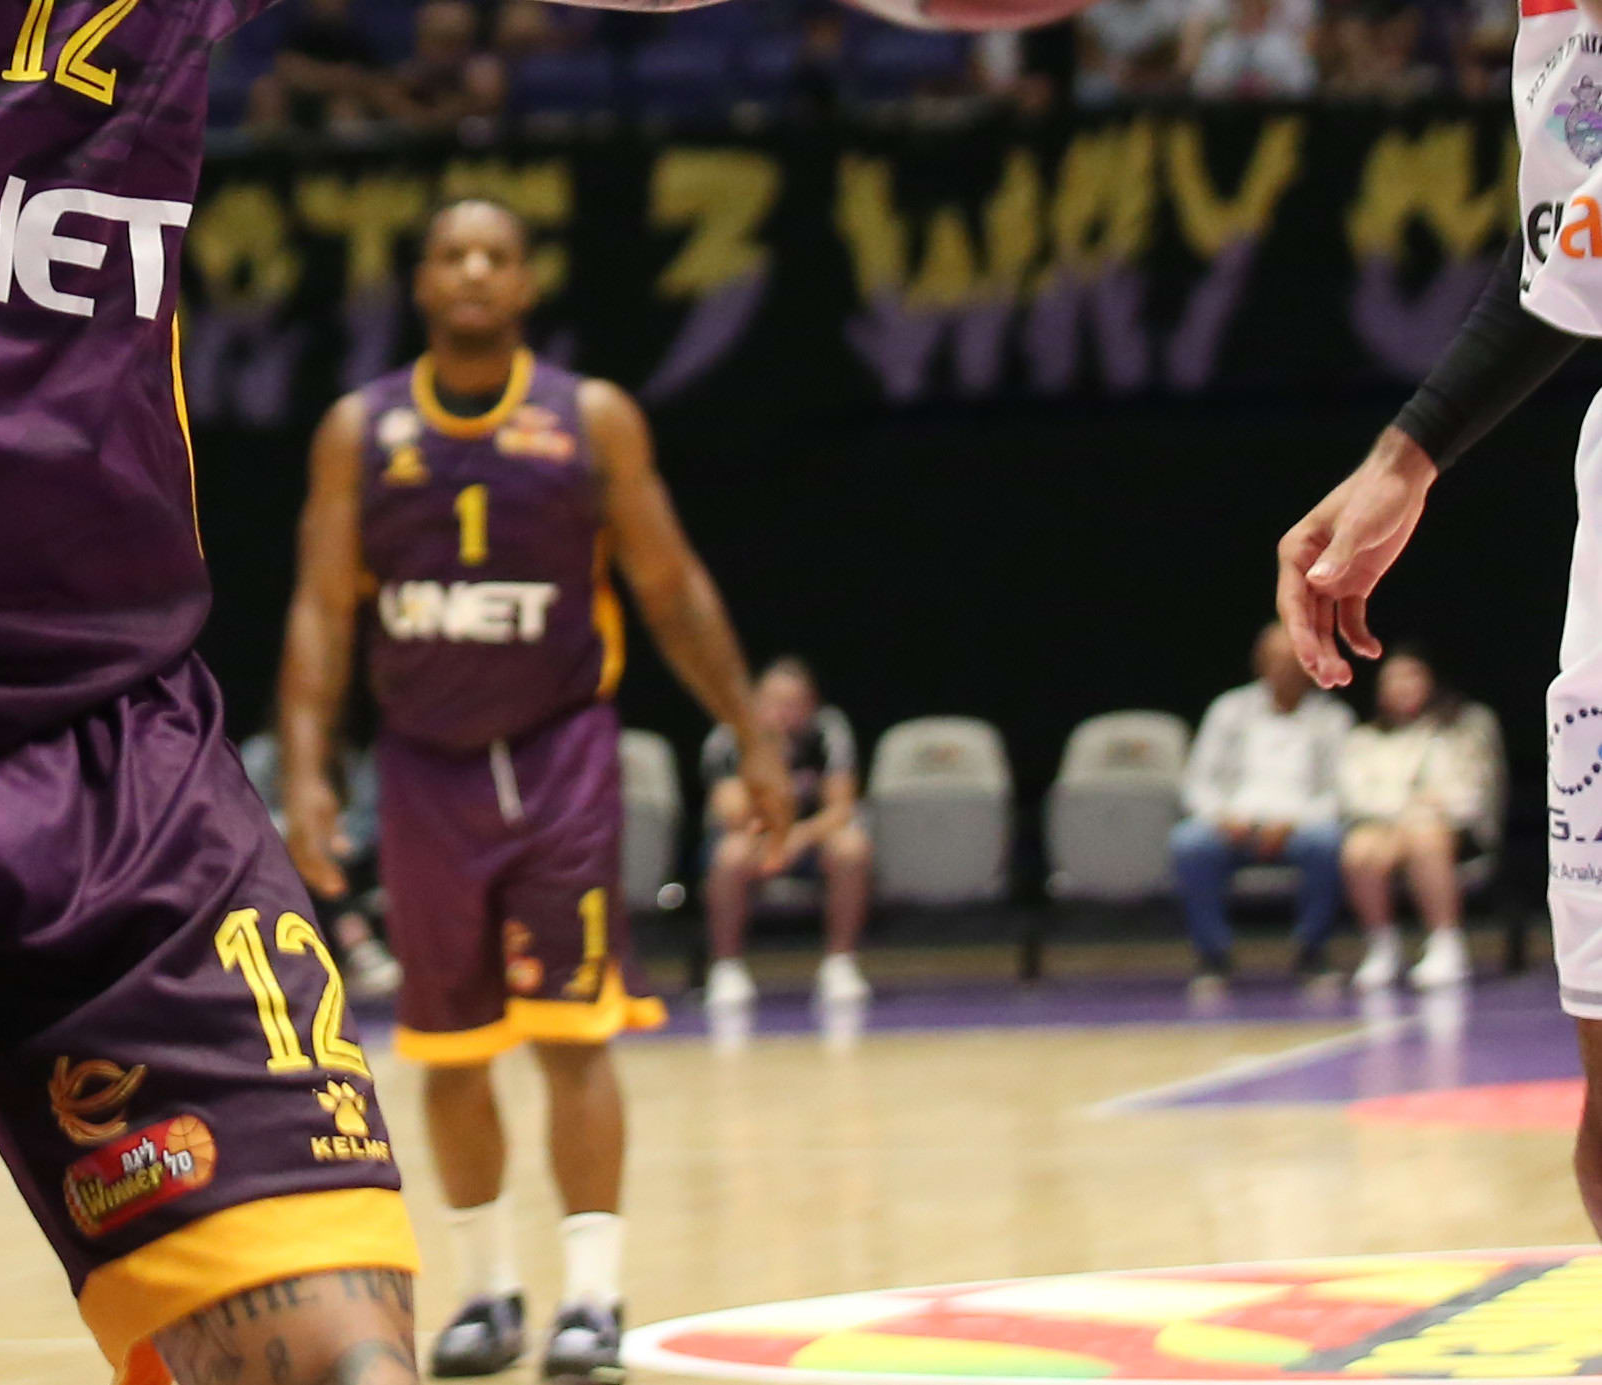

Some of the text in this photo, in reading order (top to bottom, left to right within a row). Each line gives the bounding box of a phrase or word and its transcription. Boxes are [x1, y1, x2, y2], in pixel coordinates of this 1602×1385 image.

[454, 484, 489, 565] 1
[378, 580, 561, 644] UNET
[576, 887, 608, 961] 1
[215, 907, 372, 1080] 12
[78, 1162, 163, 1219] Winner
